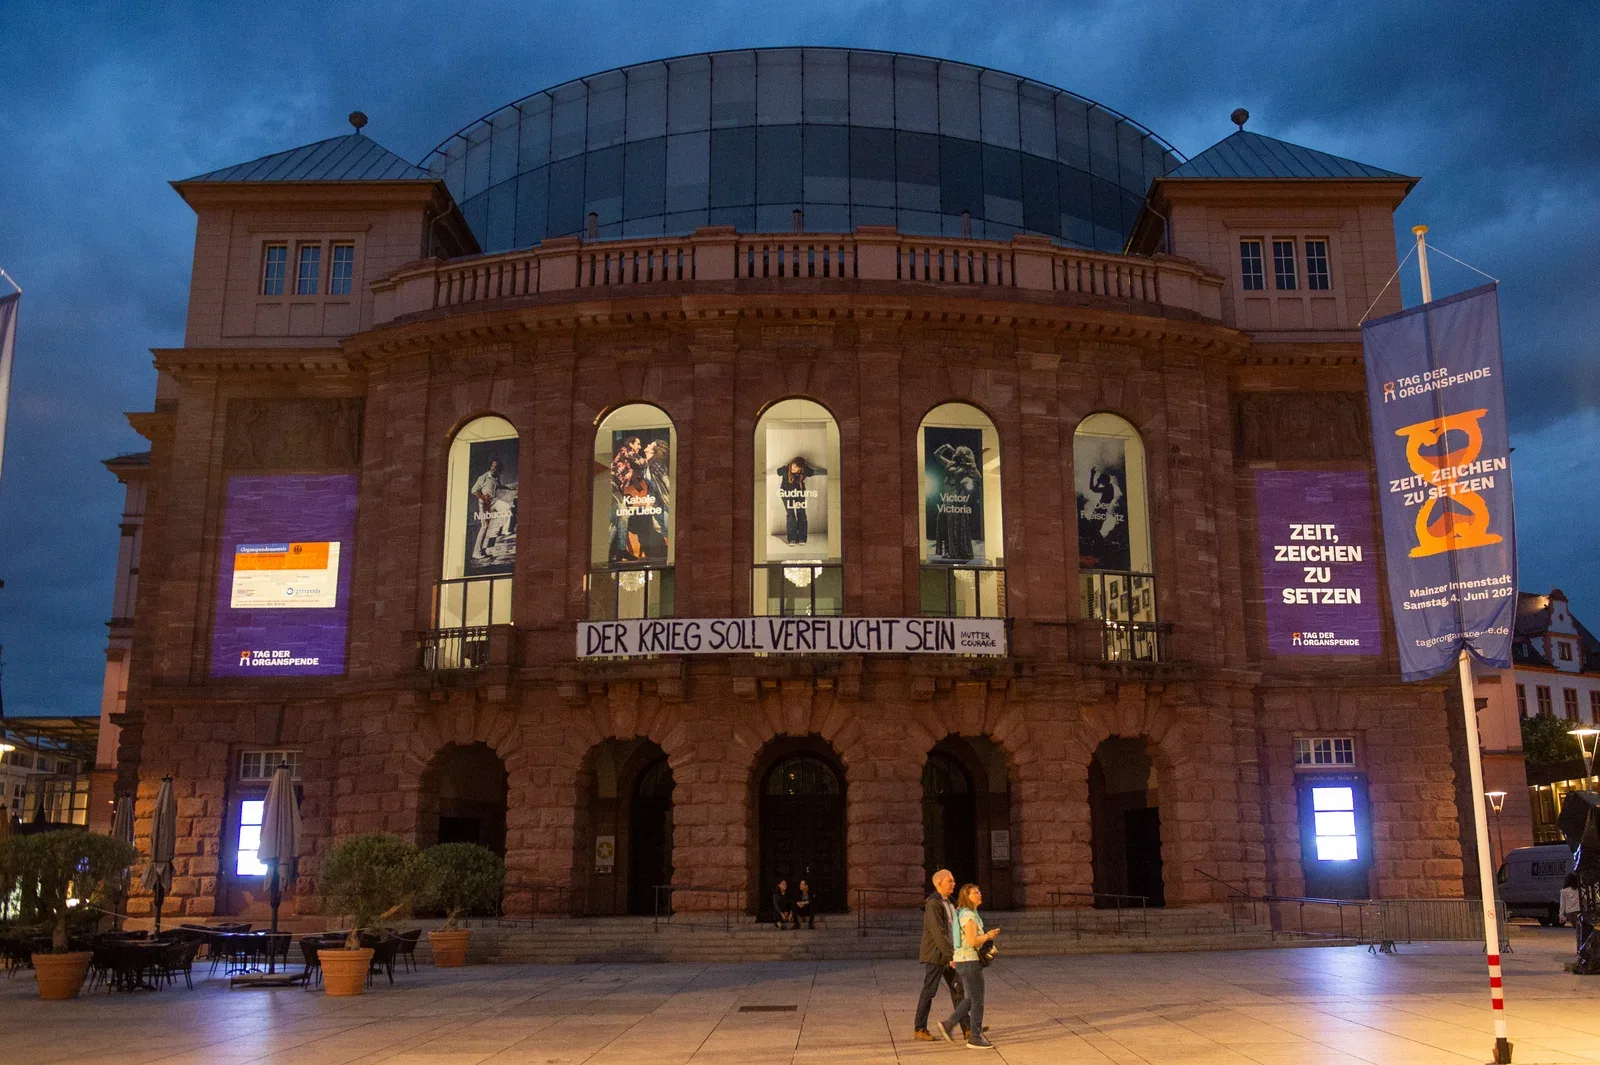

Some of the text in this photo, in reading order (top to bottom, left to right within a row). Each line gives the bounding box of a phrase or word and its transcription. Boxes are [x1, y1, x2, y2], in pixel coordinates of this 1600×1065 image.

[1397, 367, 1448, 388] TAG DER
[1399, 367, 1492, 399] ORGANSPENDE
[1389, 457, 1507, 493] ZEIT, ZEICHEN
[777, 488, 818, 498] Gudruns
[940, 493, 970, 503] Victor/
[1404, 476, 1495, 507] ZU SETZEN
[623, 494, 656, 505] Kabale
[787, 499, 808, 509] Lied
[473, 509, 512, 521] Nabucco
[616, 505, 662, 517] und Liebe
[937, 503, 972, 514] Victoria
[1289, 524, 1339, 543] ZEIT,
[1274, 545, 1362, 562] ZEICHEN
[1303, 567, 1331, 583] ZU
[1409, 574, 1512, 598] Mainzer Innenstadt
[1282, 588, 1361, 604] SETZEN
[1450, 594, 1460, 602] 4.
[1463, 589, 1489, 601] Juni
[1492, 587, 1513, 598] 202
[586, 619, 955, 656] DER KRIEG SOLL VERFLUCHT SEIN
[960, 631, 991, 640] MUTTER
[960, 639, 997, 648] COURAGE
[253, 650, 290, 658] TAG DER
[252, 658, 319, 666] ORGANSPENDE
